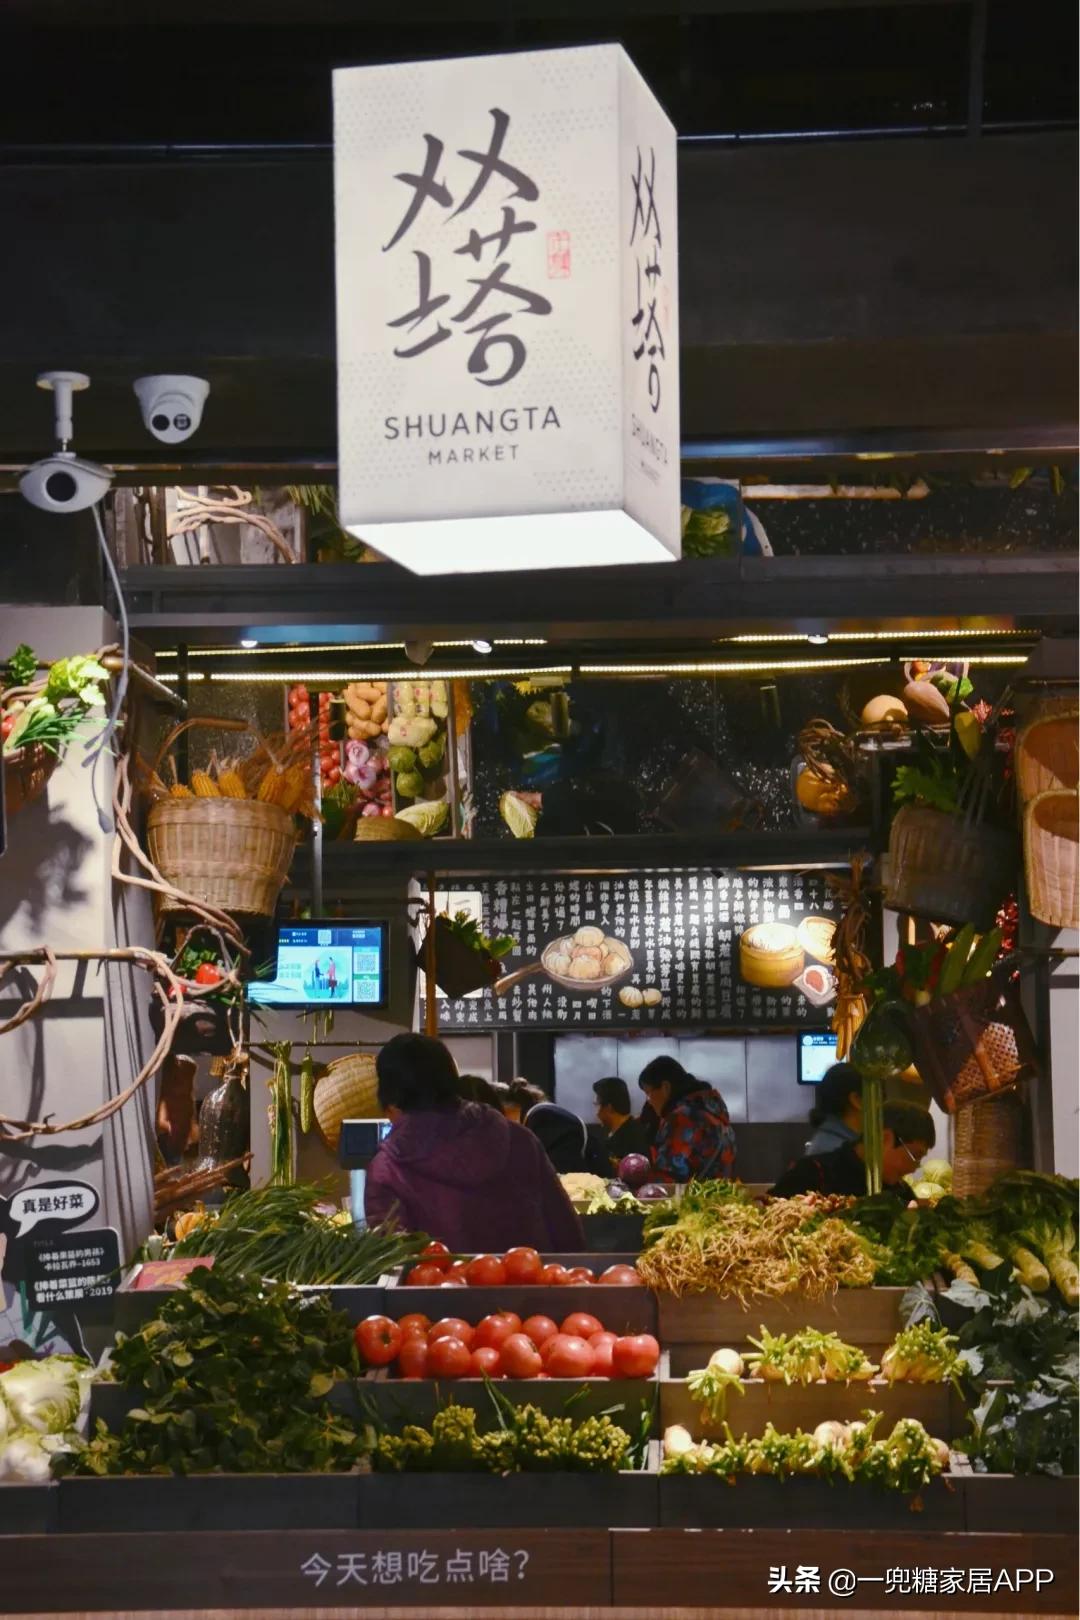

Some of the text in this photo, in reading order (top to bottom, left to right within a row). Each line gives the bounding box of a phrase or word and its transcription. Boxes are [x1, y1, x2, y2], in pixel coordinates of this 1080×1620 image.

[384, 406, 561, 440] SHUANGTA
[428, 444, 519, 466] MARKET
[22, 1193, 84, 1214] 真是好菜
